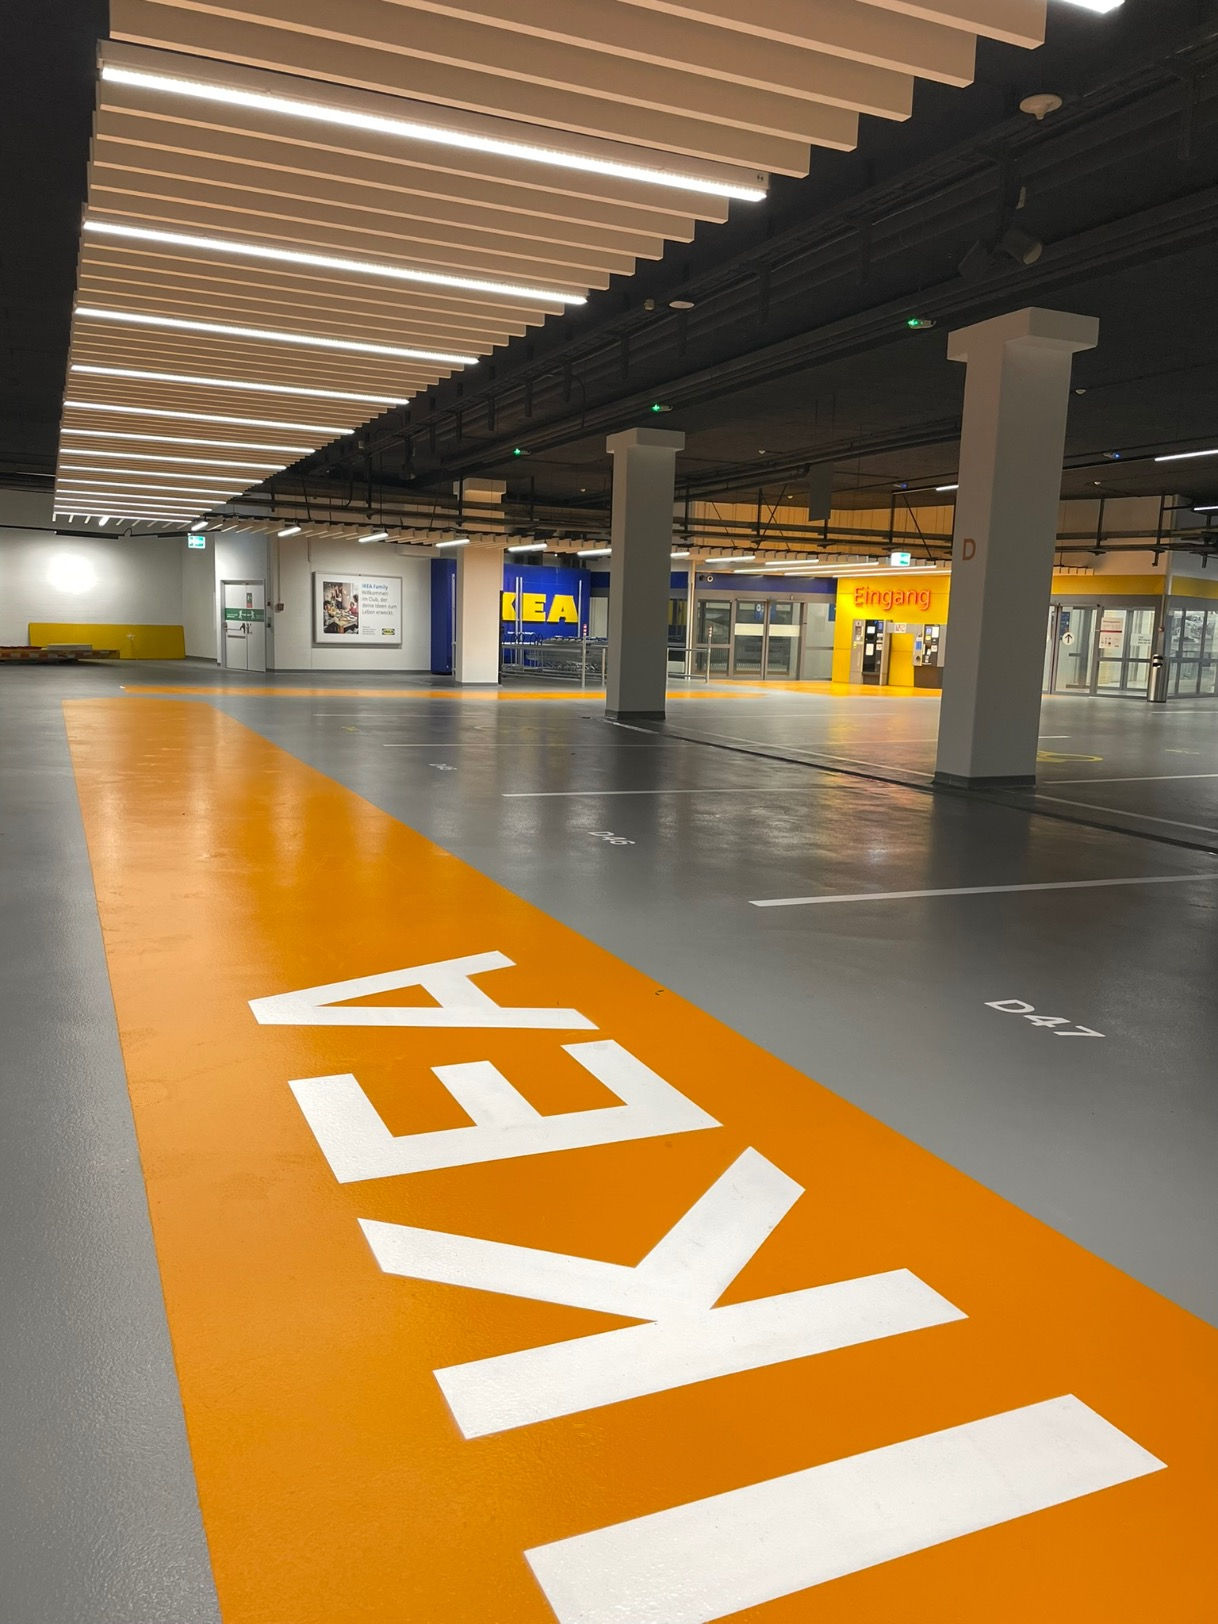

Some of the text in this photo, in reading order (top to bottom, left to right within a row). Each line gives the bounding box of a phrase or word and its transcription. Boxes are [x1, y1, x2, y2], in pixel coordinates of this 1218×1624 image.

[962, 538, 976, 561] D
[502, 592, 578, 623] KEA
[855, 586, 931, 611] Eingang
[587, 831, 636, 845] D46
[984, 999, 1106, 1038] D47
[249, 950, 1168, 1624] IKEA
